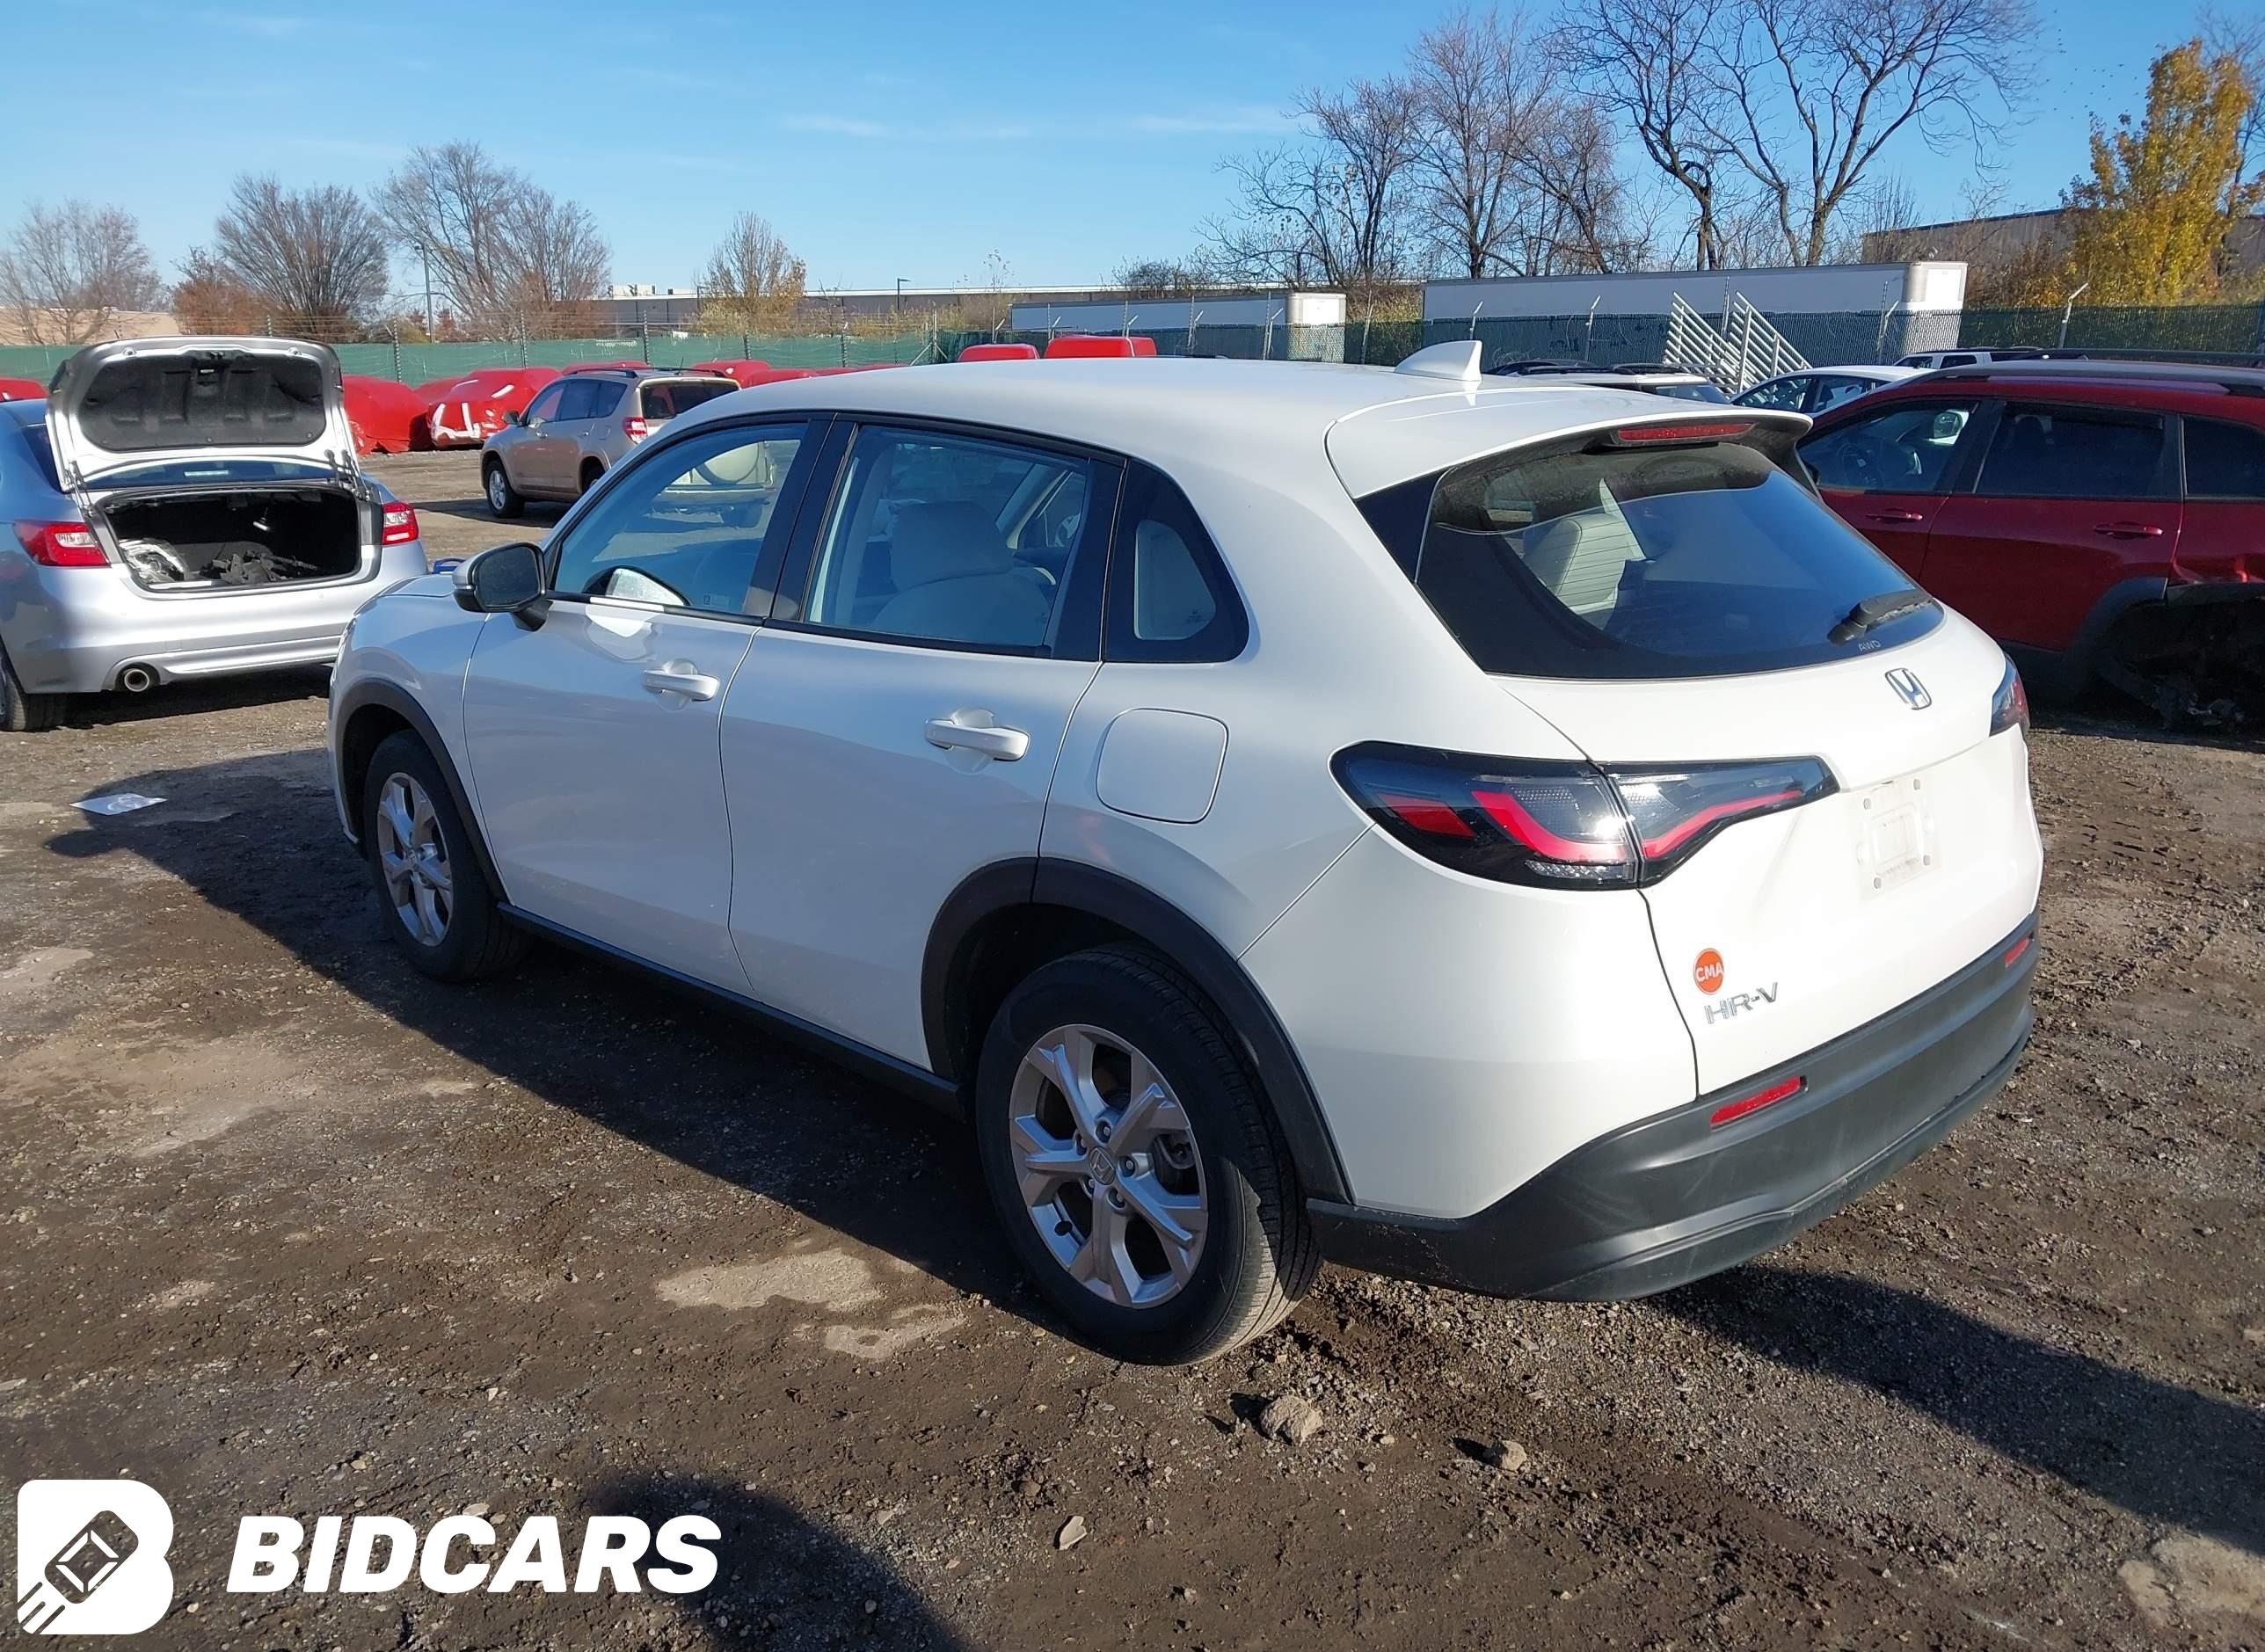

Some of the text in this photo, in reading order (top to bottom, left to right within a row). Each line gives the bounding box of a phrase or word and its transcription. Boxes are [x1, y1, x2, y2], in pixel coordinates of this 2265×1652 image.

[1858, 640, 1882, 652] AWD
[1694, 962, 1724, 982] CMA
[1704, 982, 1778, 1024] HR-V
